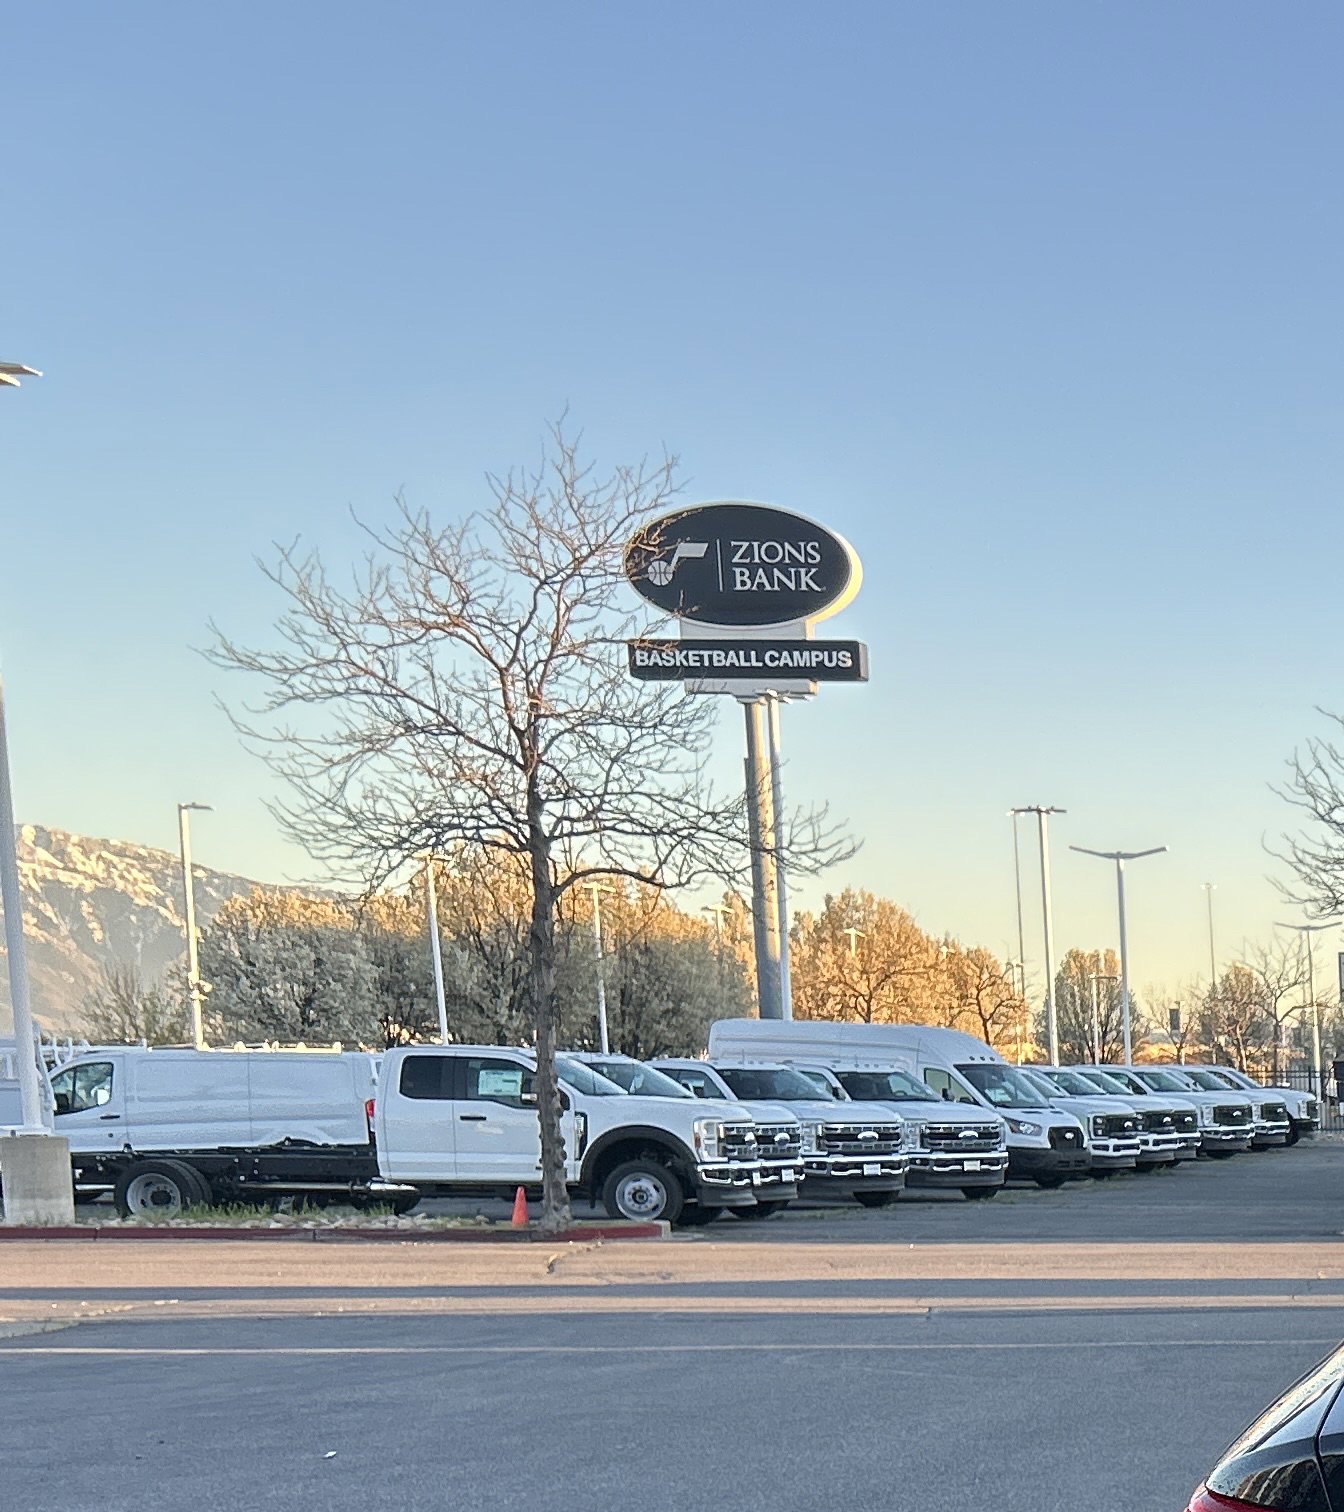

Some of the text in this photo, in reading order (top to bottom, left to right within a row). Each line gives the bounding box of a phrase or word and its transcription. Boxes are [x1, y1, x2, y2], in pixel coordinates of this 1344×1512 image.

[730, 541, 821, 564] ZIONS
[732, 567, 823, 592] BANK
[635, 650, 853, 668] BASKETBALL CAMPUS
